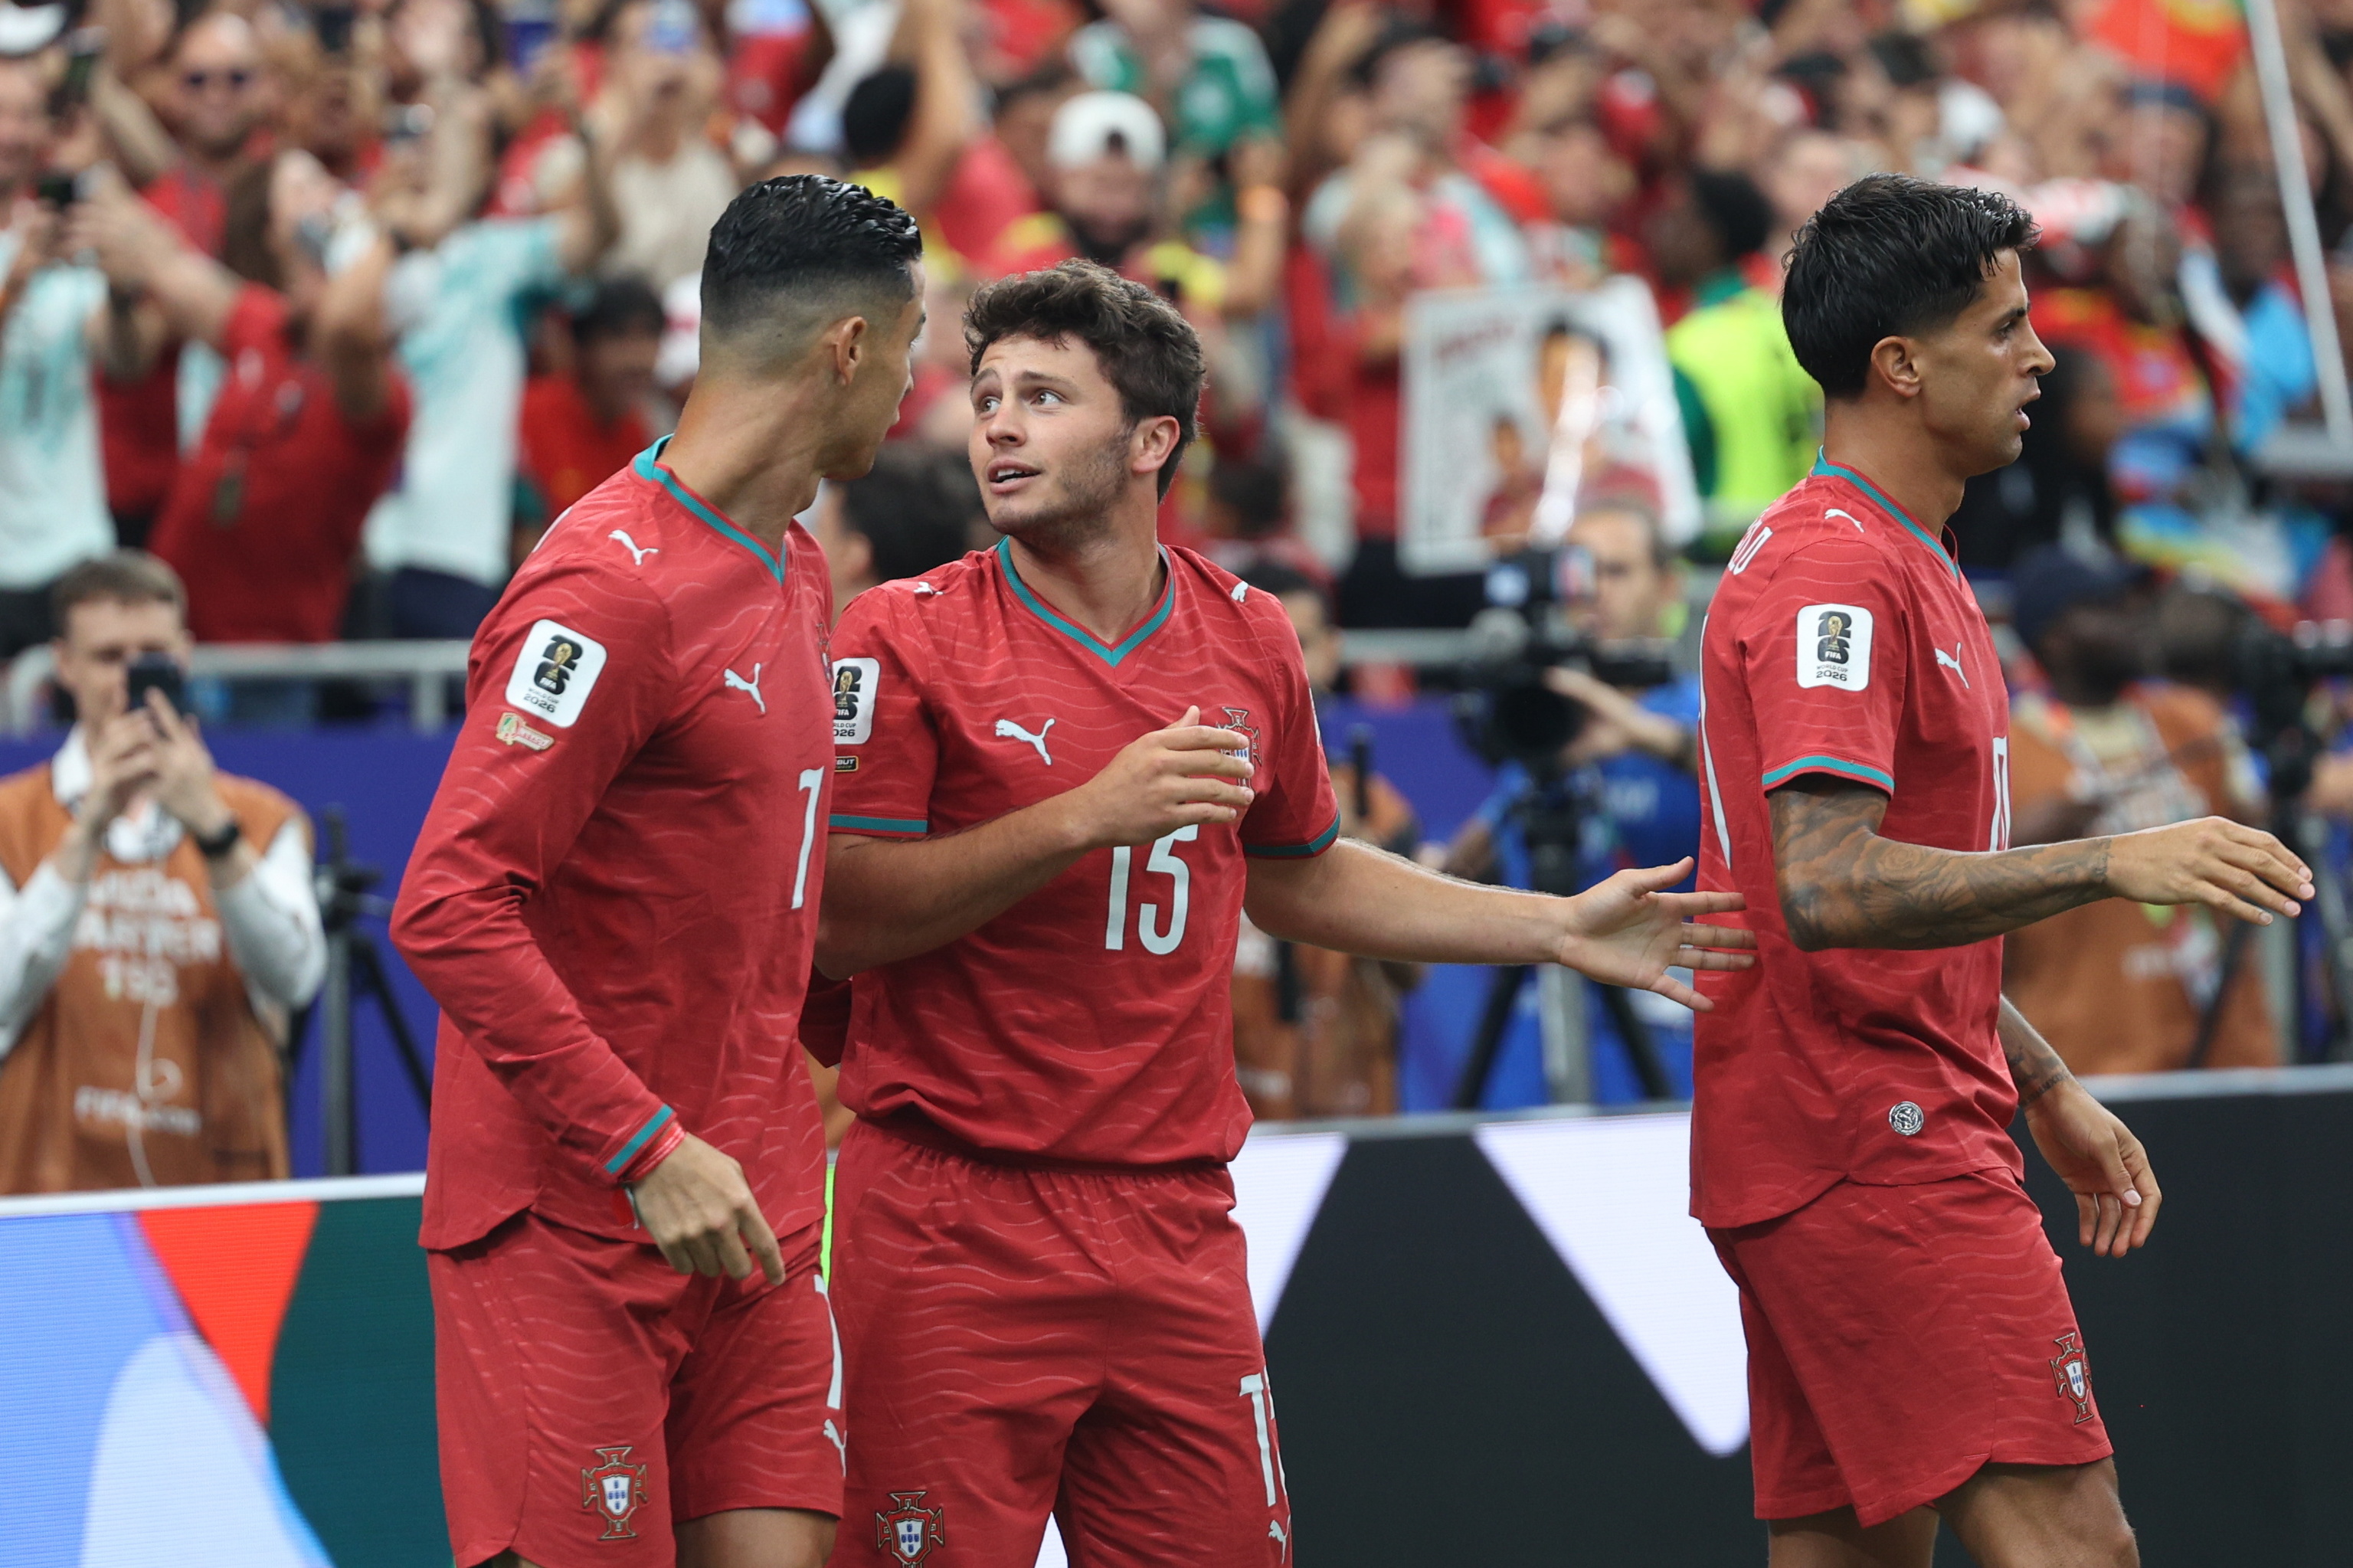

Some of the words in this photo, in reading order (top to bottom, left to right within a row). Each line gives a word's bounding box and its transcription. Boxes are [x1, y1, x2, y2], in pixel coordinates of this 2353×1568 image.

[1825, 651, 1841, 660] FIFA
[1816, 669, 1847, 682] 2026
[523, 692, 556, 713] 2026
[1105, 823, 1199, 955] 15
